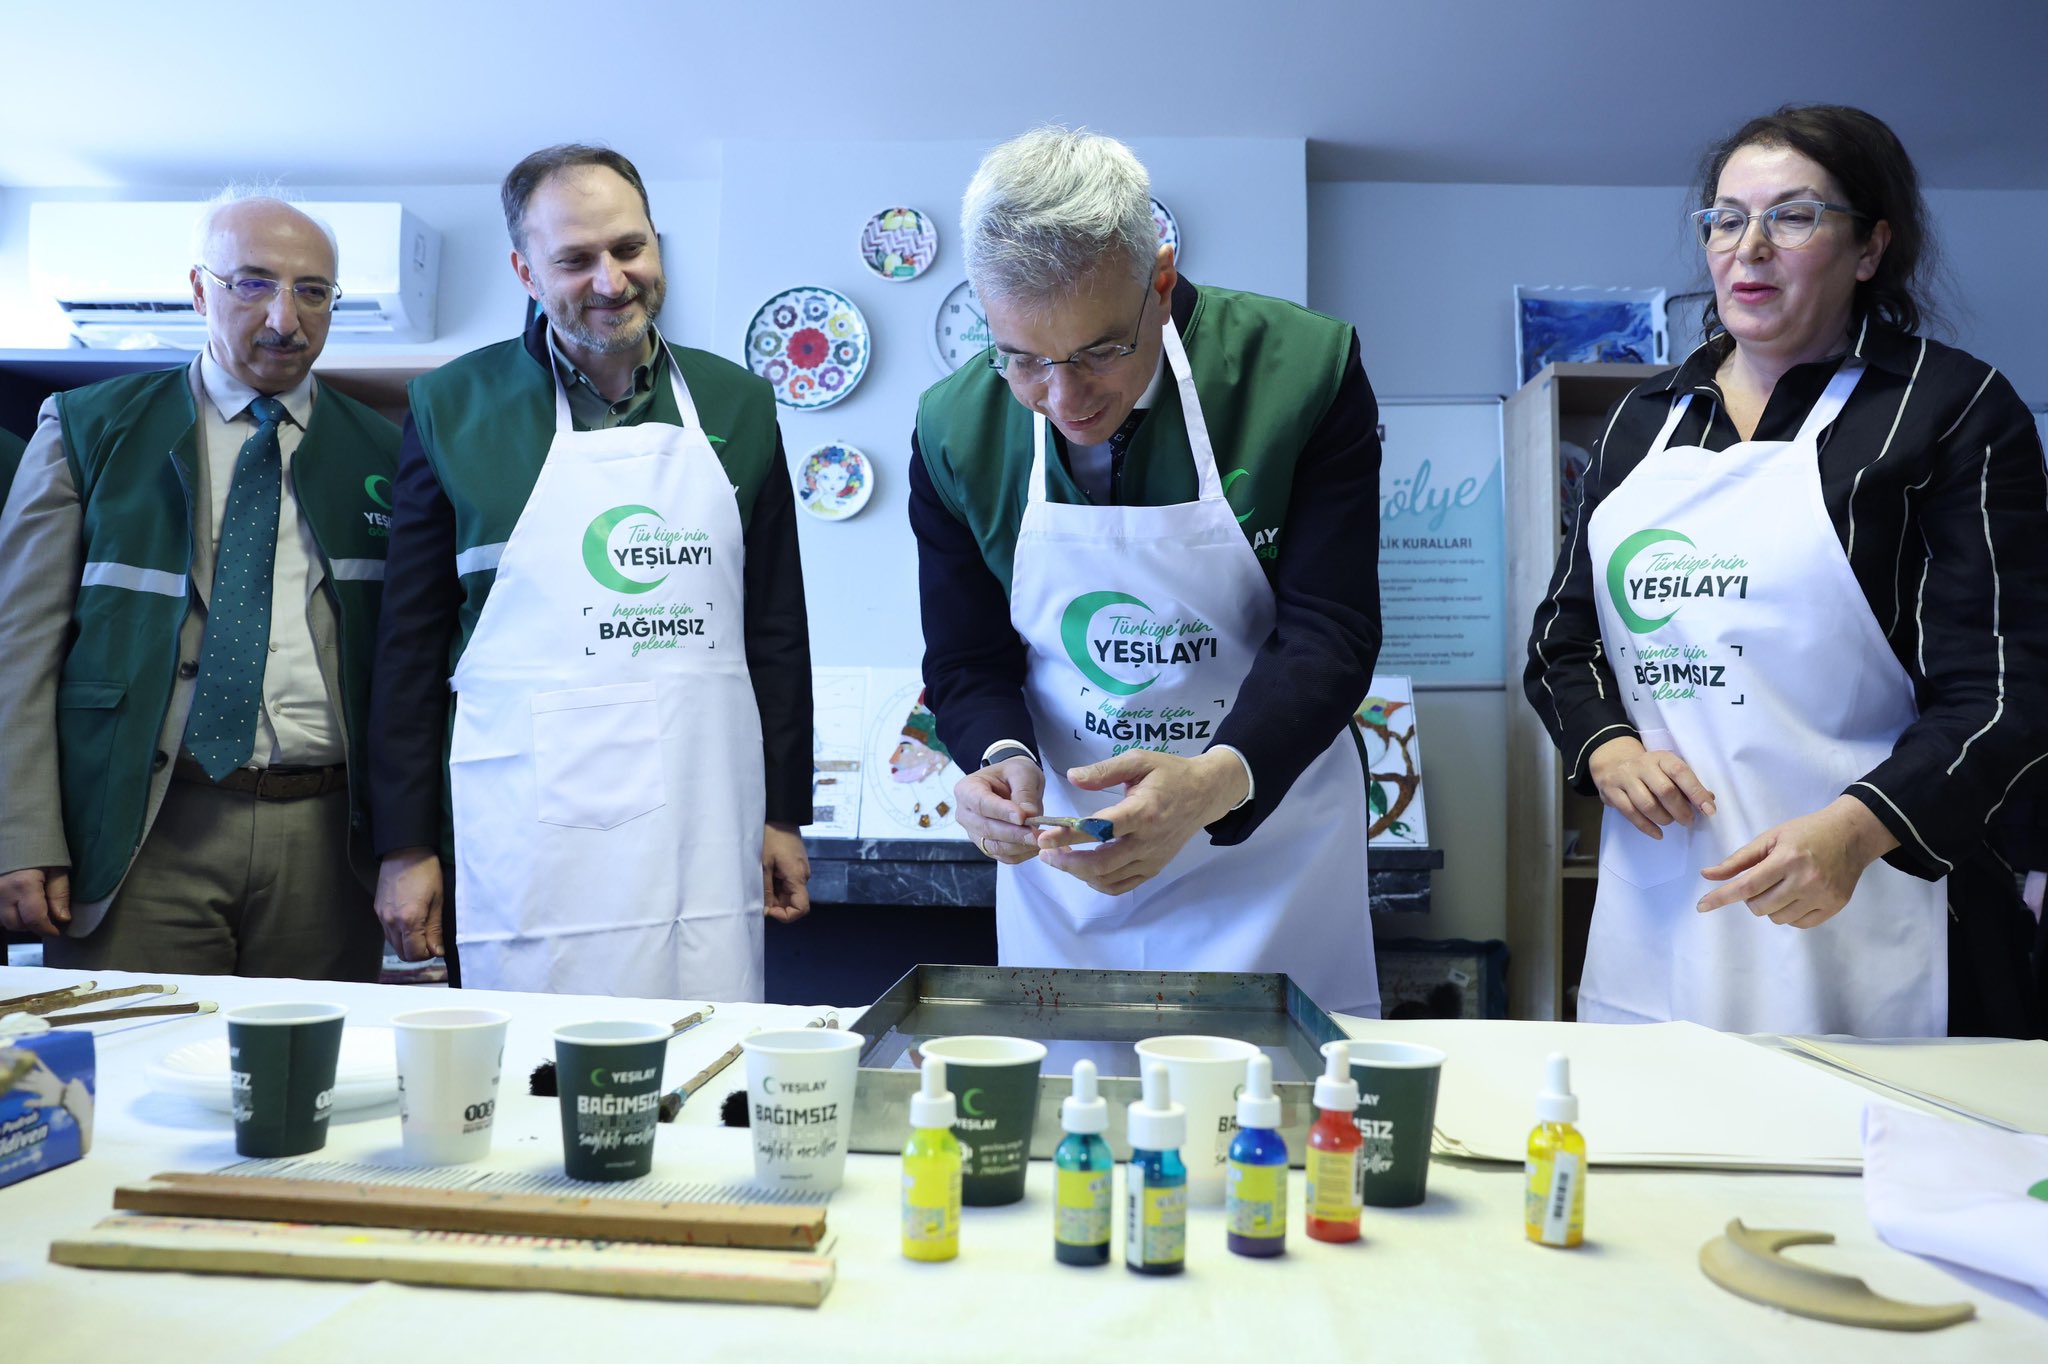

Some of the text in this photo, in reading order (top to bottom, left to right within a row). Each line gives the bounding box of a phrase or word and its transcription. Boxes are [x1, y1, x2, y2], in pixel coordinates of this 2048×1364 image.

[950, 305, 960, 314] 10
[945, 326, 952, 336] 9
[950, 349, 956, 358] 8
[1380, 458, 1481, 532] ölye
[628, 524, 709, 547] Türkiye'nin
[1254, 527, 1279, 550] AY
[1402, 536, 1472, 549] KURALLARI
[1645, 552, 1749, 576] Türkiye'nin
[612, 603, 694, 619] hepimiz için
[599, 617, 705, 640] BAĞIMSIZ
[1109, 615, 1213, 644] Türkiye'nin
[1684, 644, 1708, 663] için
[1098, 698, 1195, 722] hepimiz için
[1085, 711, 1211, 742] BAĞIMSIZ
[756, 1103, 838, 1125] BAĞIMSIZ
